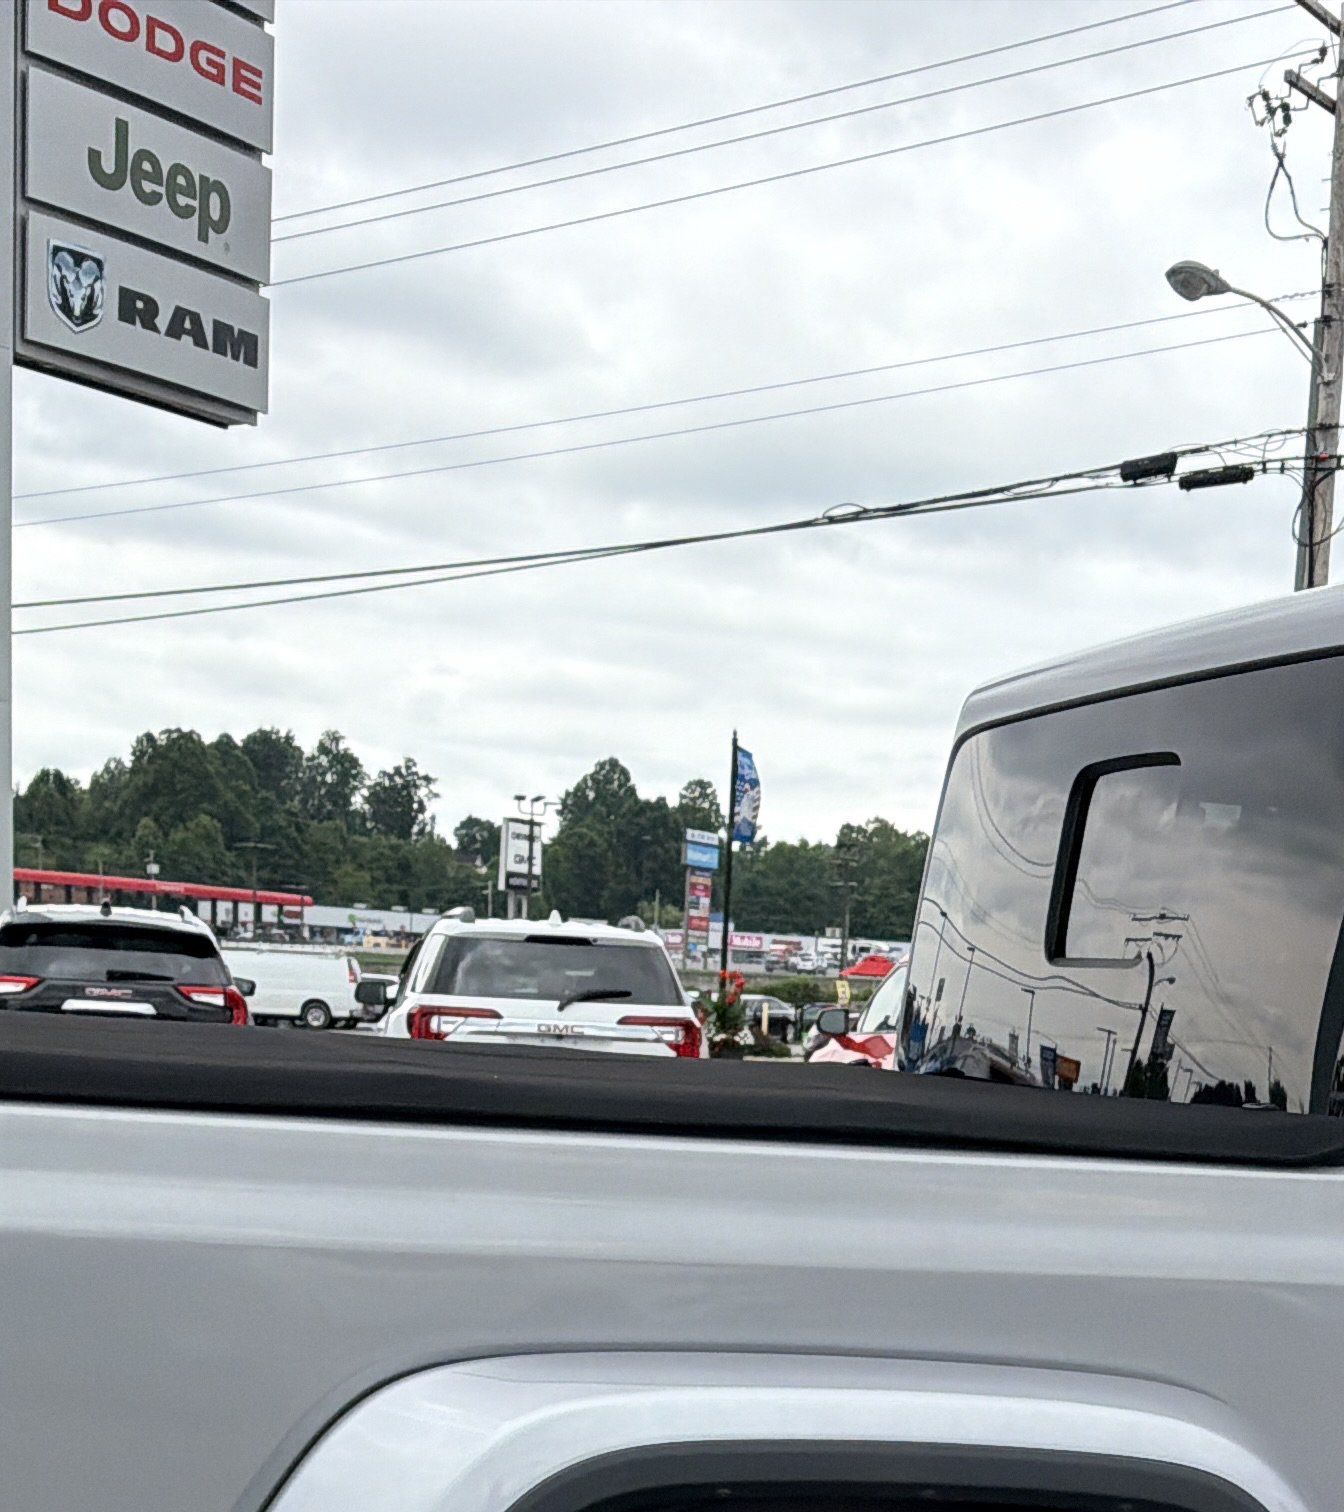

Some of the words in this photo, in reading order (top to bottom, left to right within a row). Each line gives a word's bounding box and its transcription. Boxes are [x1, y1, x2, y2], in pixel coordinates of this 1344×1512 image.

[87, 116, 230, 244] Jeep
[118, 285, 259, 369] RAM
[537, 1023, 584, 1035] GMC
